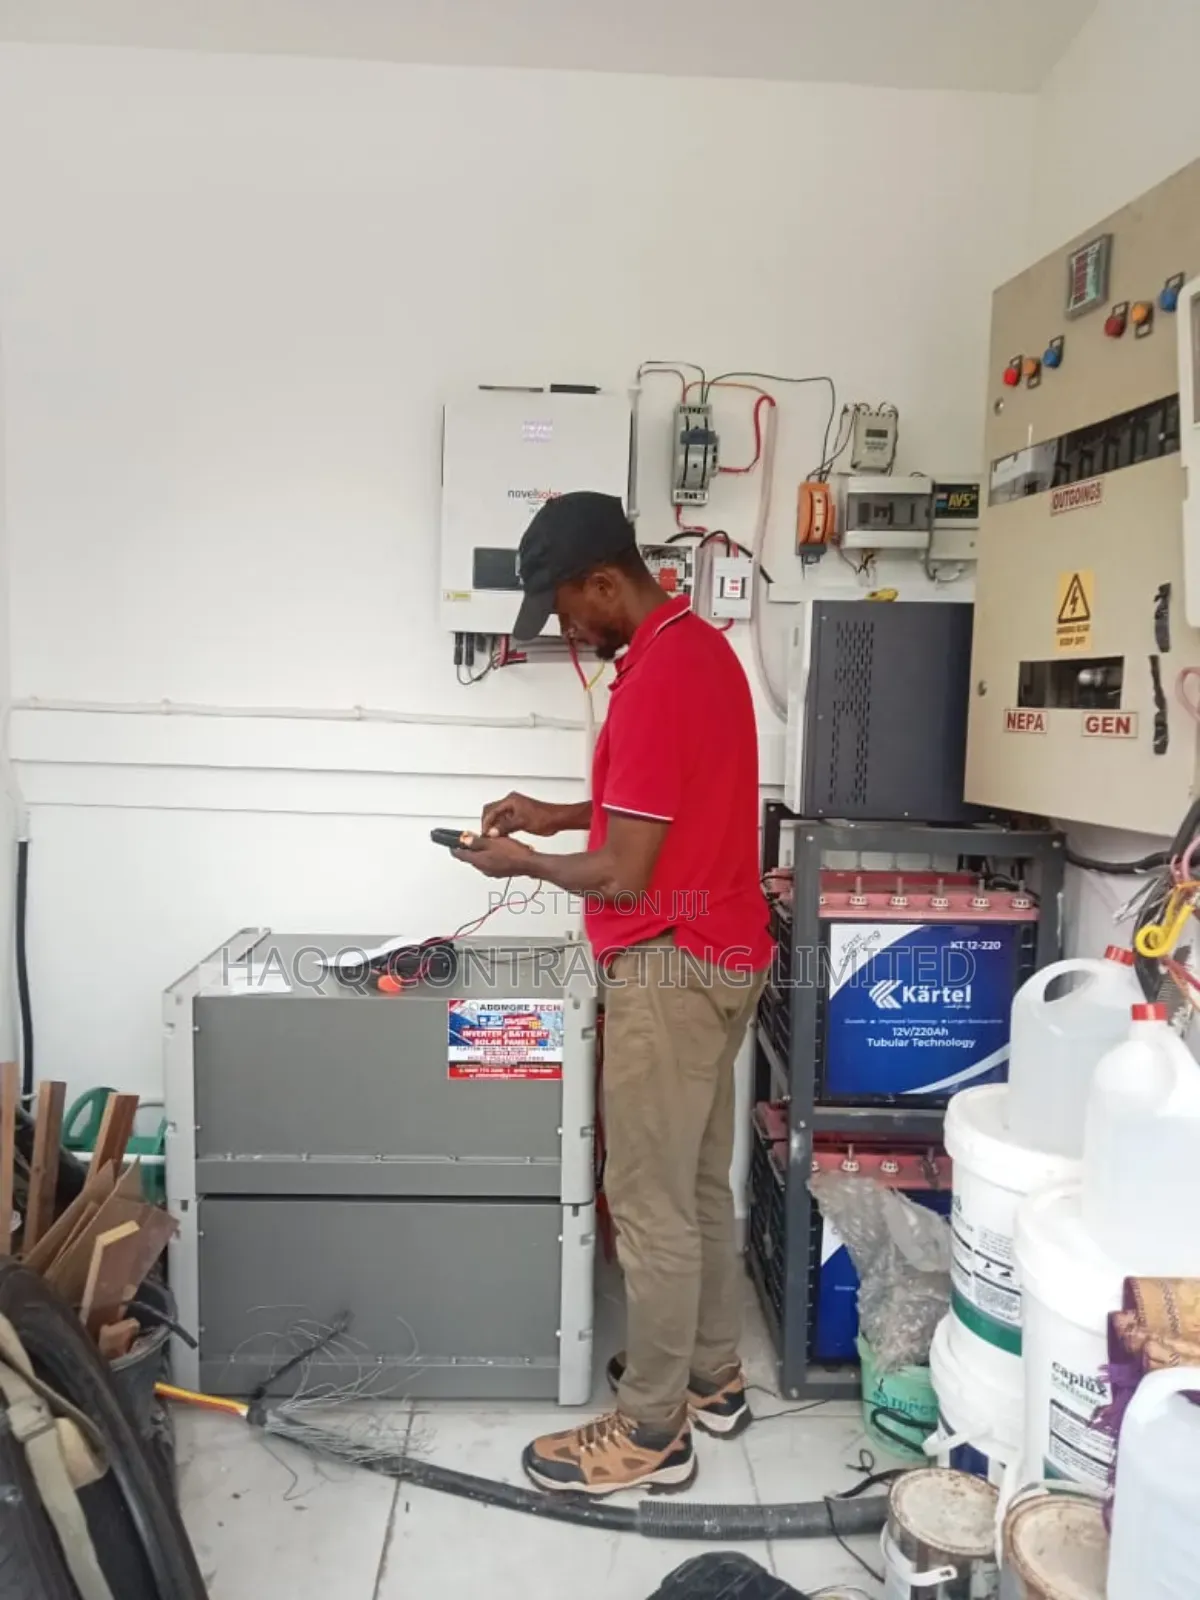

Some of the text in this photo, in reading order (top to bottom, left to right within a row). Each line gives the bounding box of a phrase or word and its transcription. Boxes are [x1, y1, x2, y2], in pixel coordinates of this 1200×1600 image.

[1007, 712, 1044, 731] NEPA
[1085, 716, 1131, 734] GEN
[902, 984, 972, 1004] Kärtel
[892, 1026, 949, 1037] 12V/220Ah
[866, 1037, 976, 1049] Tubular Technology
